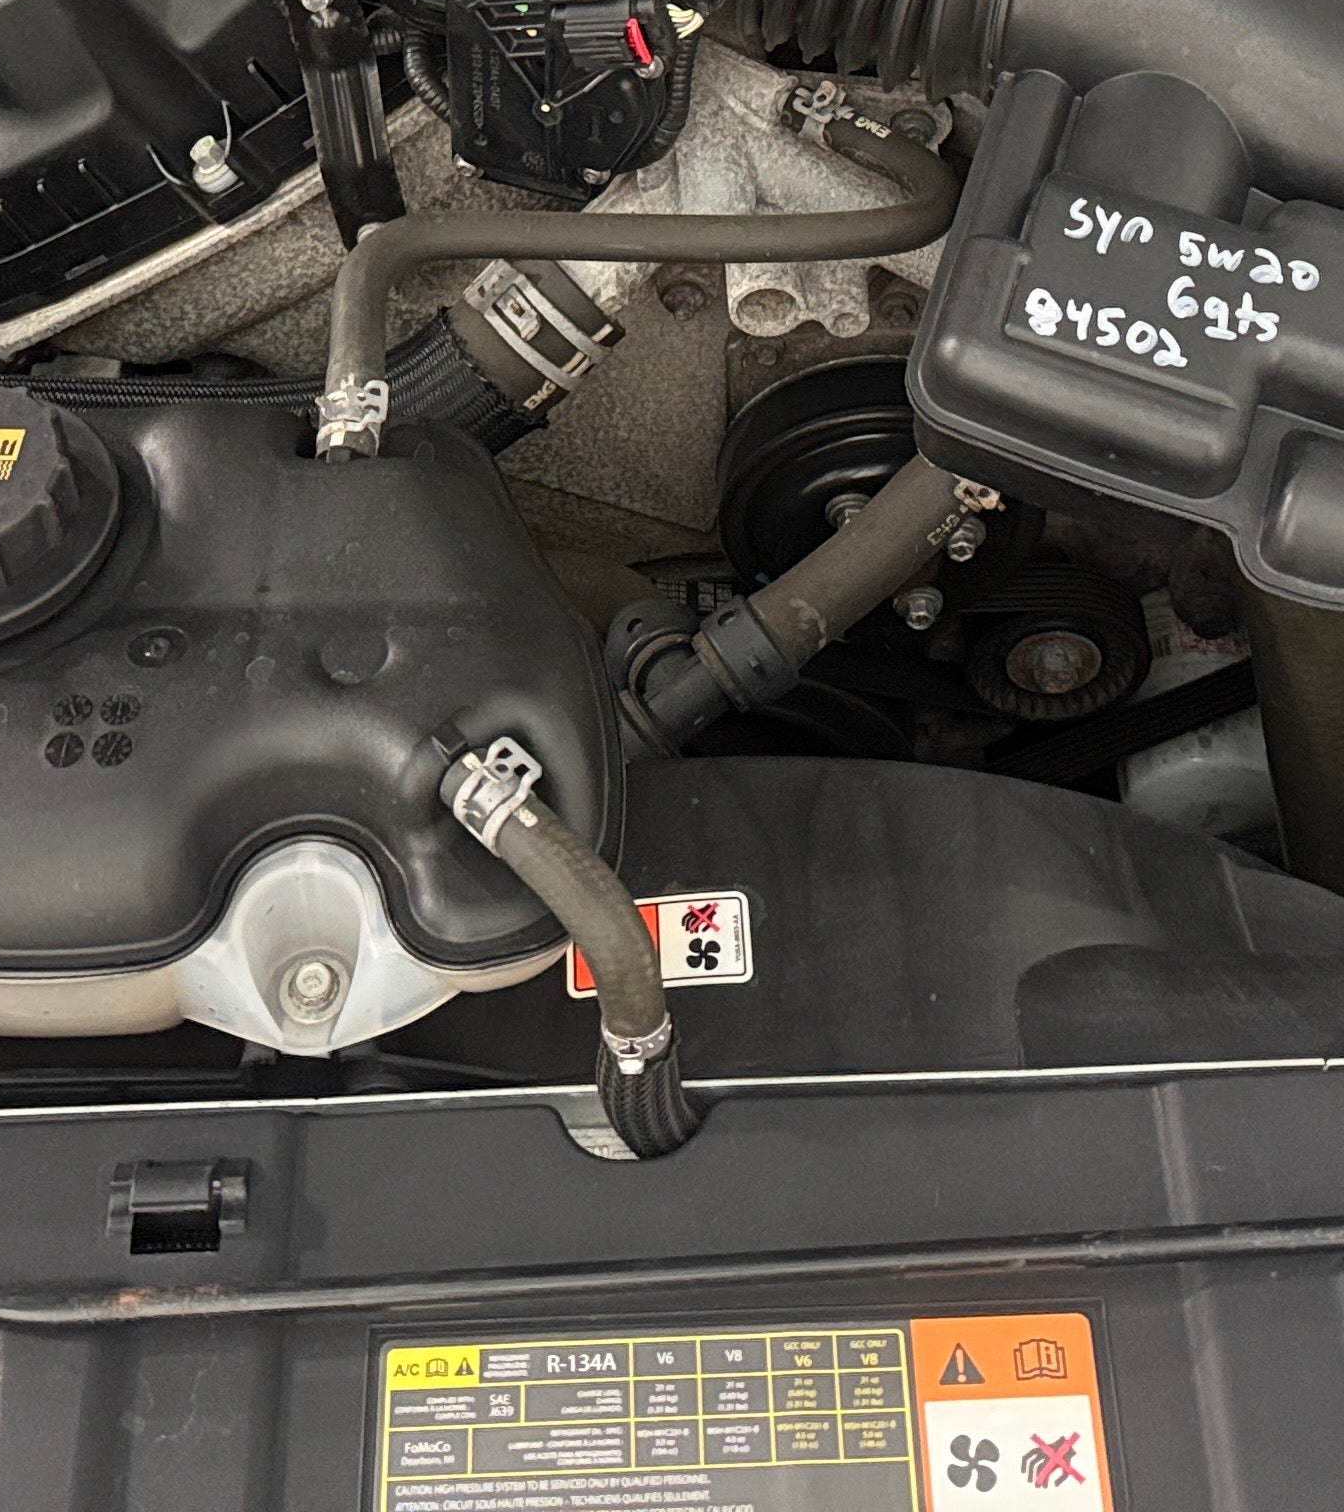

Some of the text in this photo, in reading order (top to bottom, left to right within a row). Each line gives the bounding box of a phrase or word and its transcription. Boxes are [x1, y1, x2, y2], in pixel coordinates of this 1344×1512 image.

[547, 1352, 617, 1373] R-134A
[656, 1352, 675, 1365] V6
[725, 1349, 744, 1363] V8
[794, 1354, 813, 1367] V6
[860, 1353, 879, 1366] V8
[393, 1362, 421, 1377] A/C
[489, 1394, 511, 1406] SAE
[404, 1441, 452, 1454] FoMoCo
[434, 1483, 455, 1494] HIGH
[456, 1482, 494, 1493] PRESSURE
[495, 1481, 525, 1492] SYSTEM
[526, 1481, 538, 1491] TO
[539, 1480, 549, 1491] BE
[550, 1478, 587, 1490] SERVICED
[588, 1477, 609, 1488] ONLY
[609, 1477, 620, 1487] BY
[621, 1475, 663, 1487] QUALIFIED
[442, 1499, 474, 1511] CIRCUIT
[475, 1498, 496, 1510] SOUS
[497, 1497, 524, 1509] HAUTE
[525, 1496, 563, 1508] PRESSION
[570, 1493, 621, 1506] TECHNICIENS
